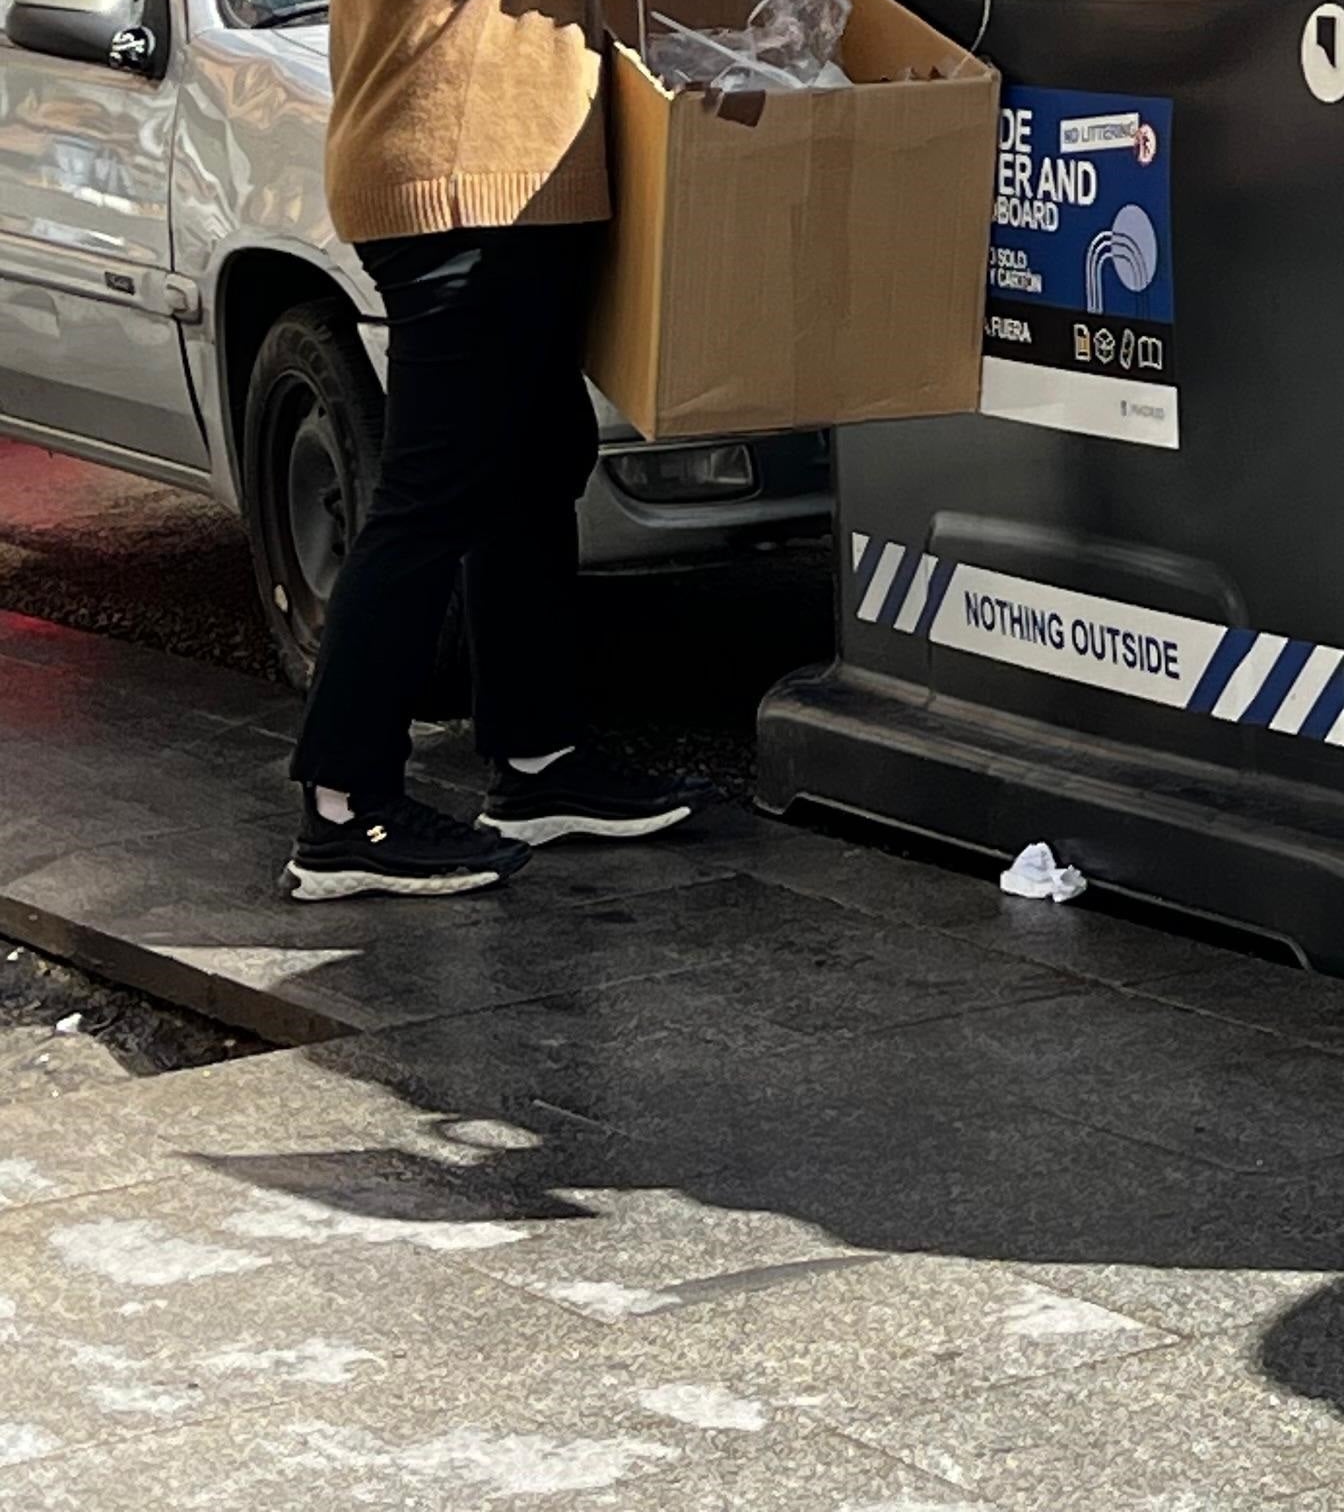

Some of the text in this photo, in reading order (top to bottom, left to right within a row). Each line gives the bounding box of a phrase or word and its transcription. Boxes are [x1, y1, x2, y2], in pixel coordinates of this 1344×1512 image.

[1037, 156, 1097, 206] AND
[995, 196, 1059, 232] BOARD
[991, 316, 1032, 343] FUERA
[964, 591, 1180, 680] NOTHING OUTSIDE
